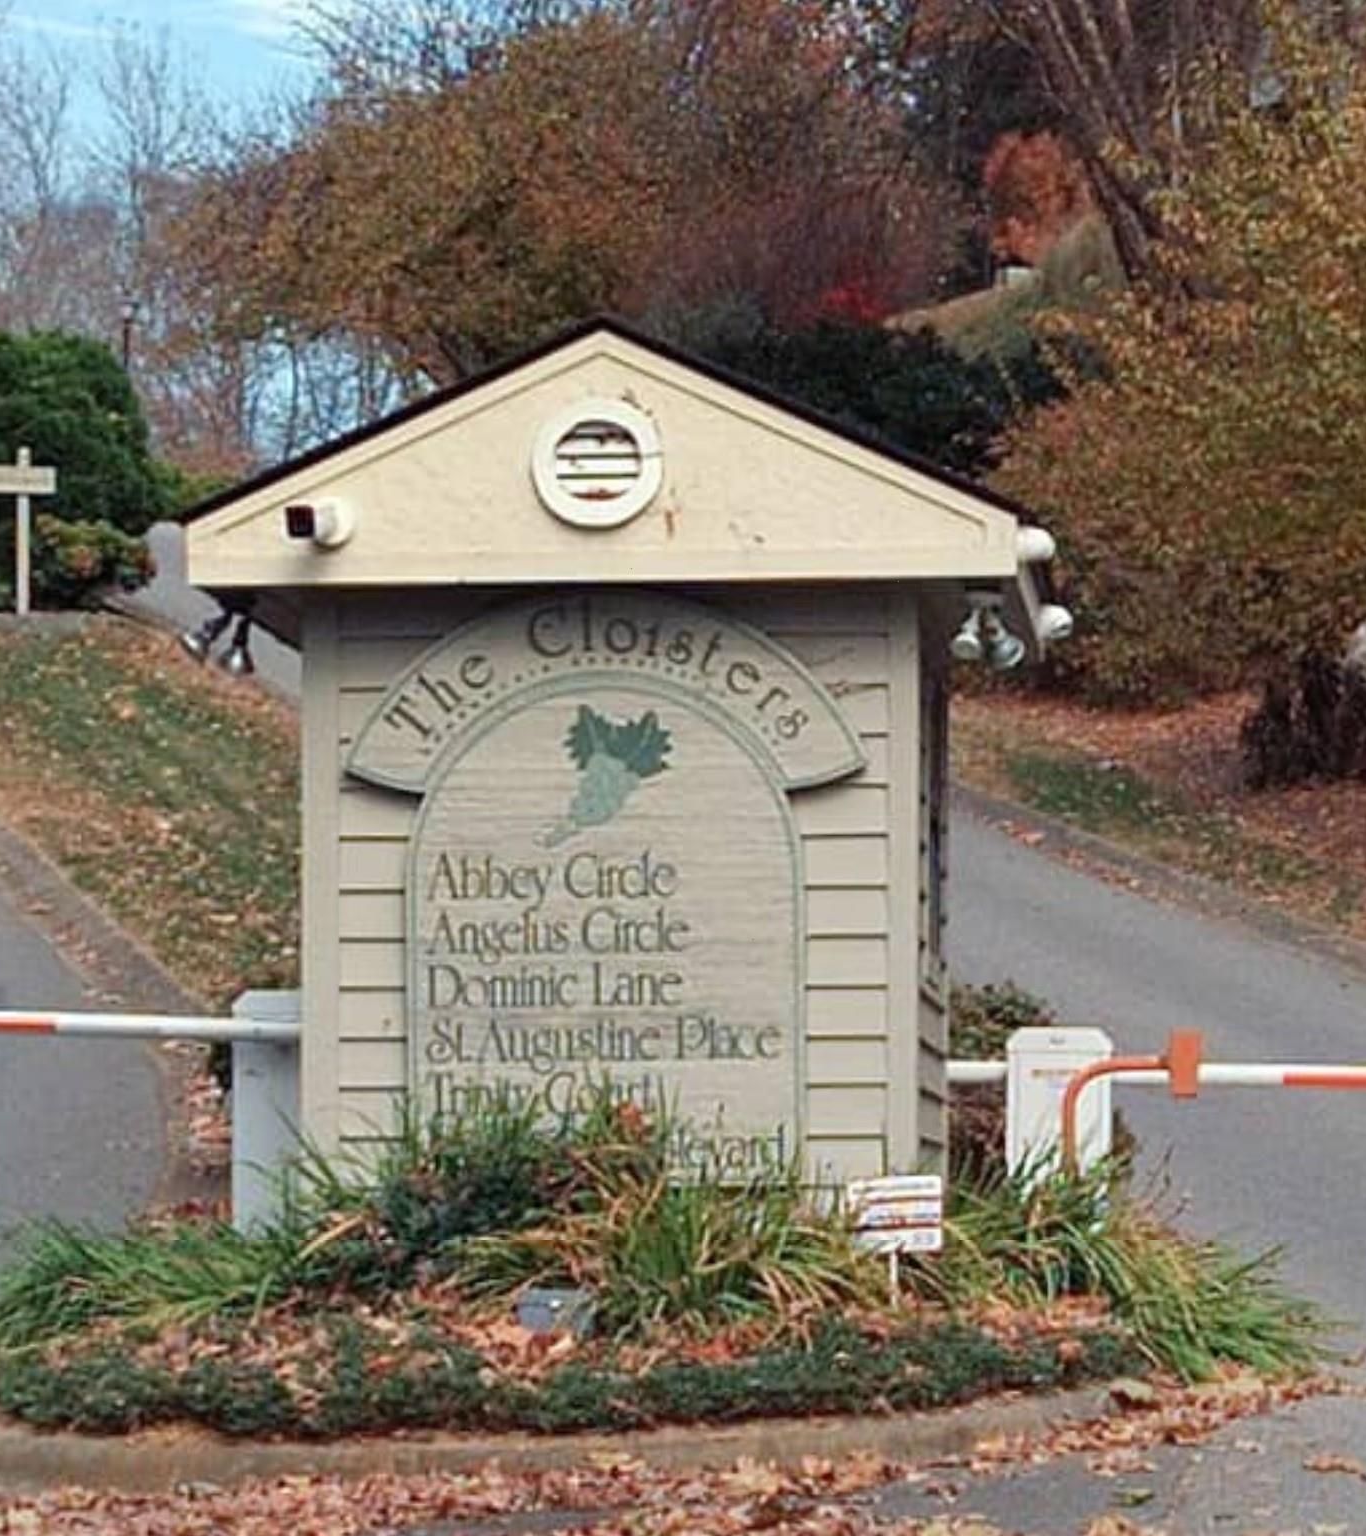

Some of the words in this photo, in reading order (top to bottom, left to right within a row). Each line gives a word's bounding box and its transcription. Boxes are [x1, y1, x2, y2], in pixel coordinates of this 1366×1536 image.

[382, 651, 495, 746] The
[526, 599, 809, 741] Cloisters
[428, 852, 552, 906] Abbey
[564, 851, 677, 899] Circle
[425, 909, 569, 965] Angelus
[581, 905, 690, 954] Circle
[426, 963, 579, 1009] Dominic
[592, 962, 684, 1007] Lane
[476, 1017, 661, 1075] Augustine
[675, 1014, 782, 1062] Place
